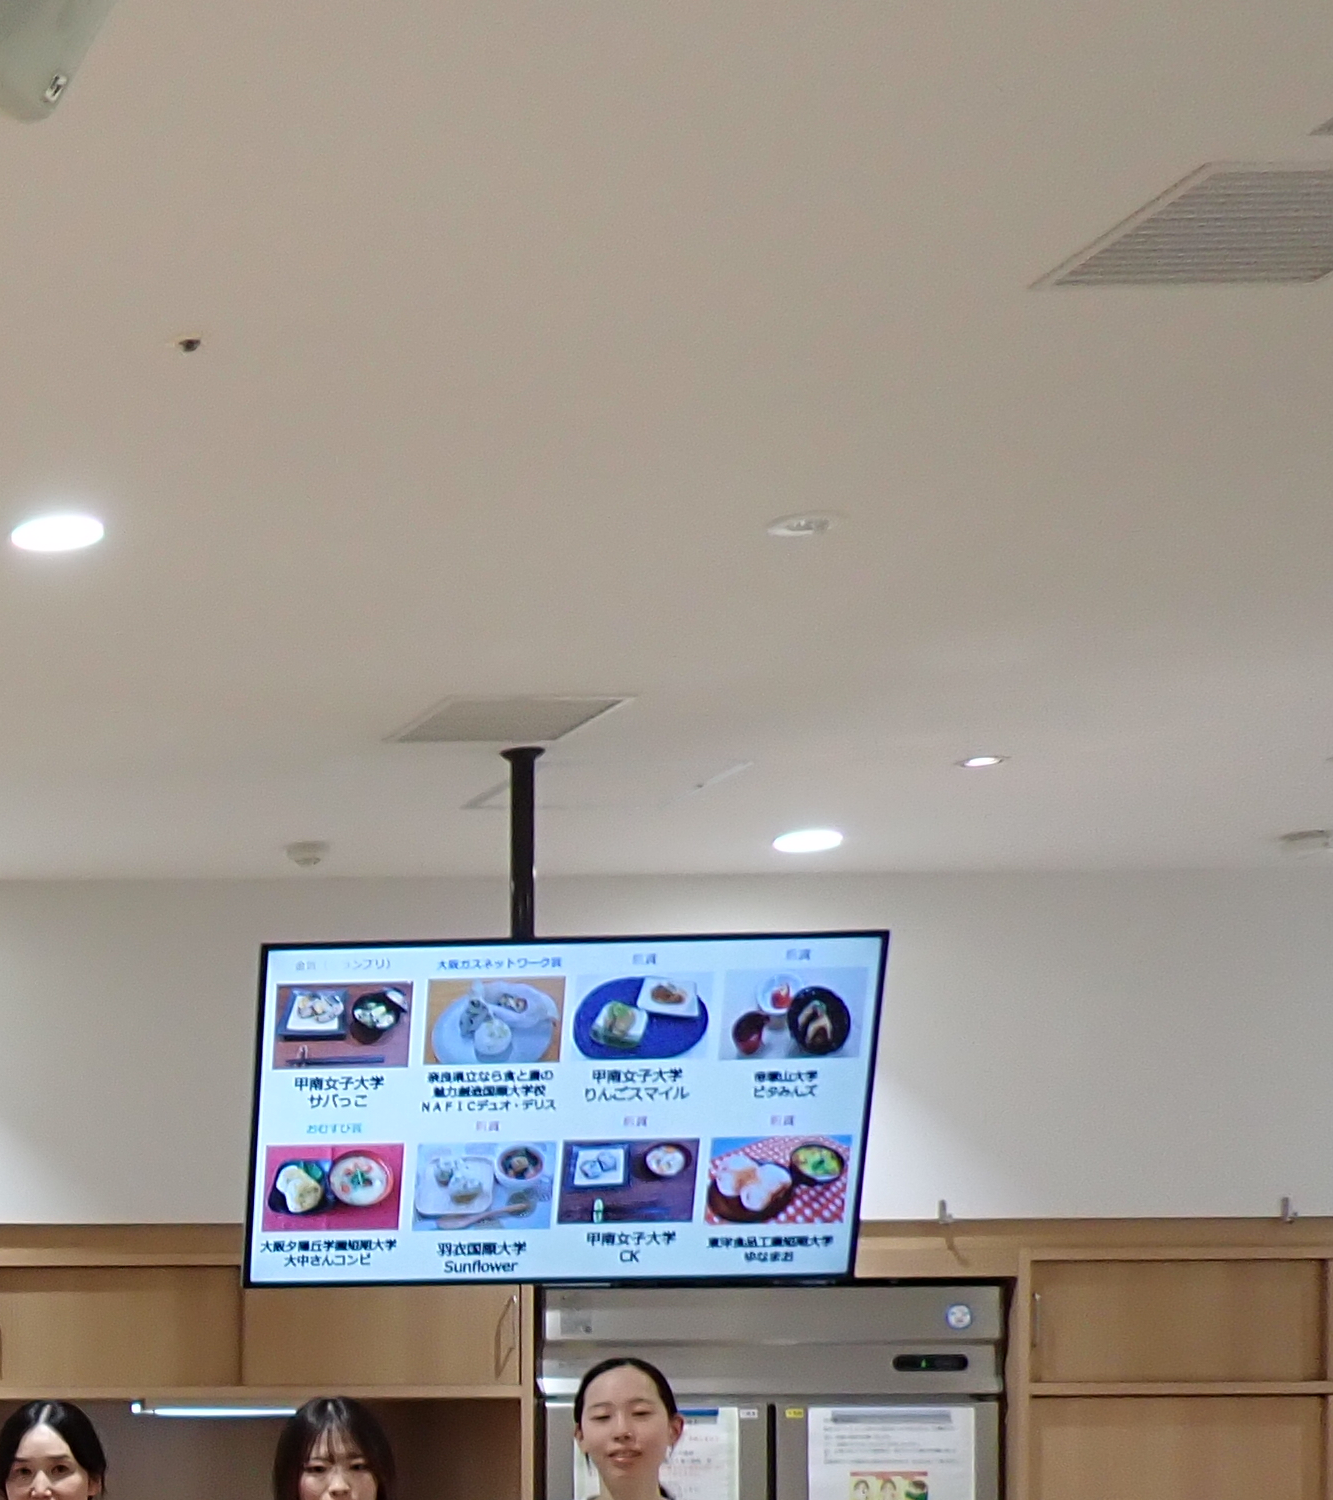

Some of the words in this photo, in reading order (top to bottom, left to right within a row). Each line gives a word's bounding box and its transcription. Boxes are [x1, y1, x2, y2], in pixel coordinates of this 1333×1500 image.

[592, 1068, 683, 1083] 甲南女子大学
[294, 1076, 385, 1091] 甲南女子大学
[584, 1085, 690, 1102] りんごスマイル
[307, 1094, 368, 1109] サバっこ
[586, 1231, 677, 1246] 甲南女子大学
[619, 1250, 640, 1263] CK
[444, 1260, 518, 1274] Sunflower
